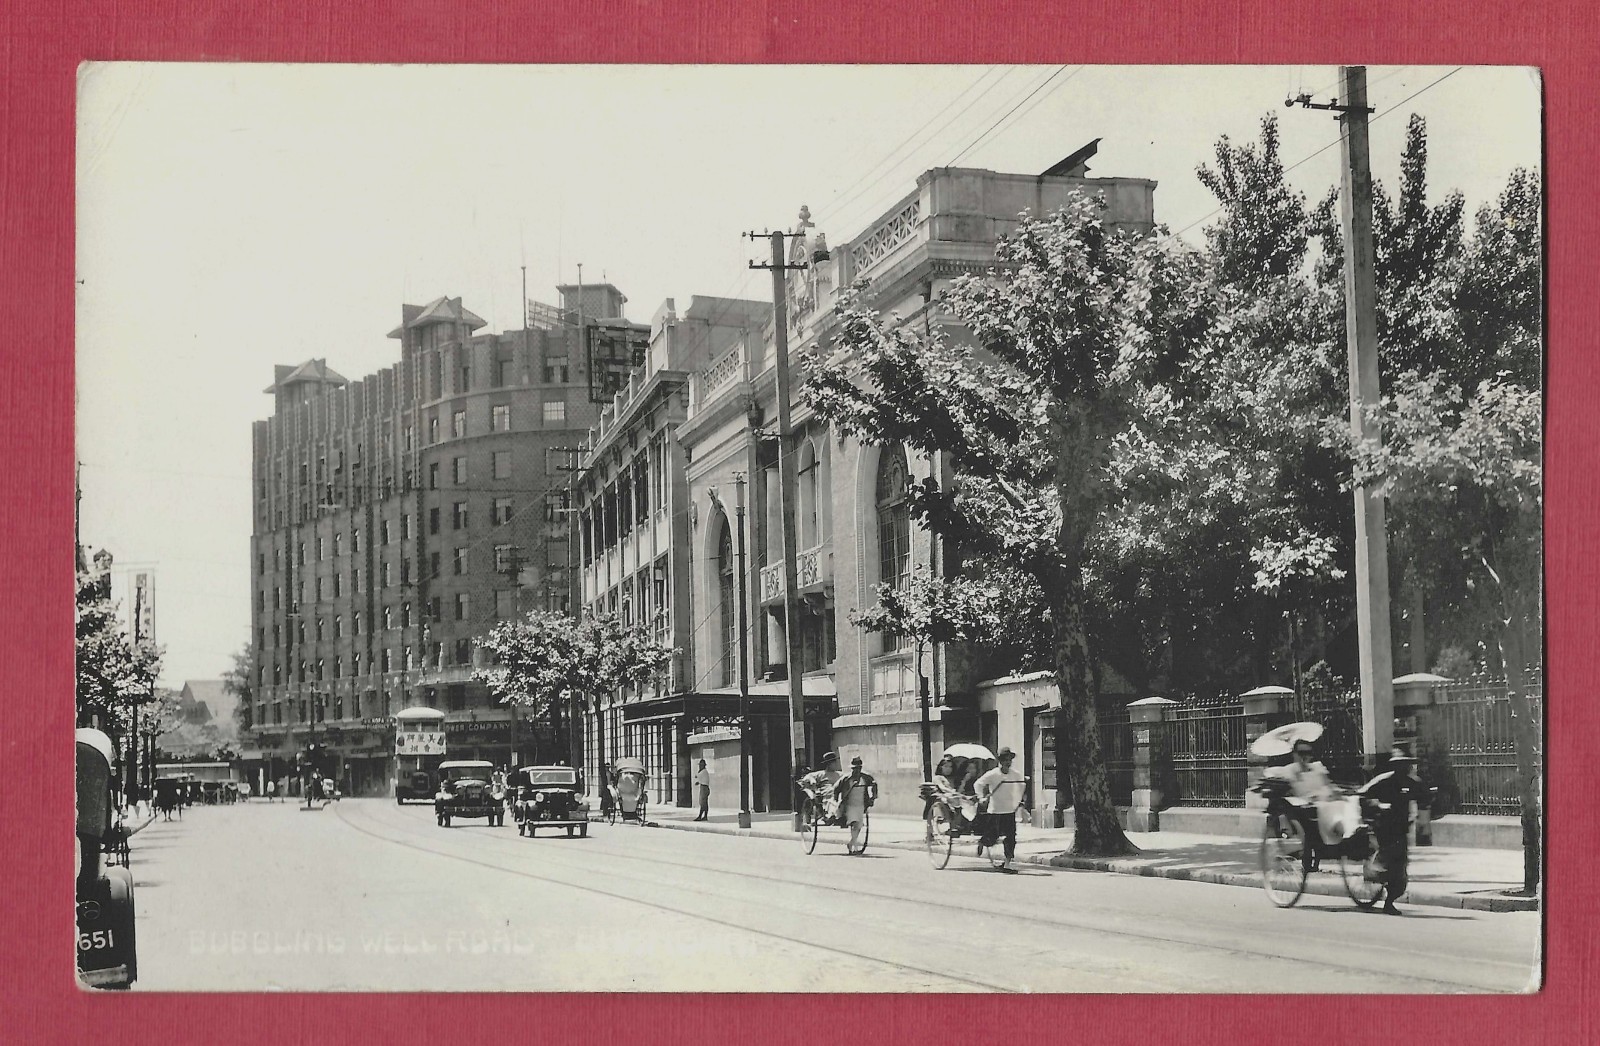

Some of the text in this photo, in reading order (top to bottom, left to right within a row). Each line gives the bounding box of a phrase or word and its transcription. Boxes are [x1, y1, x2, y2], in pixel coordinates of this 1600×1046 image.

[446, 722, 510, 732] OWER COMPANY
[79, 930, 113, 950] 651
